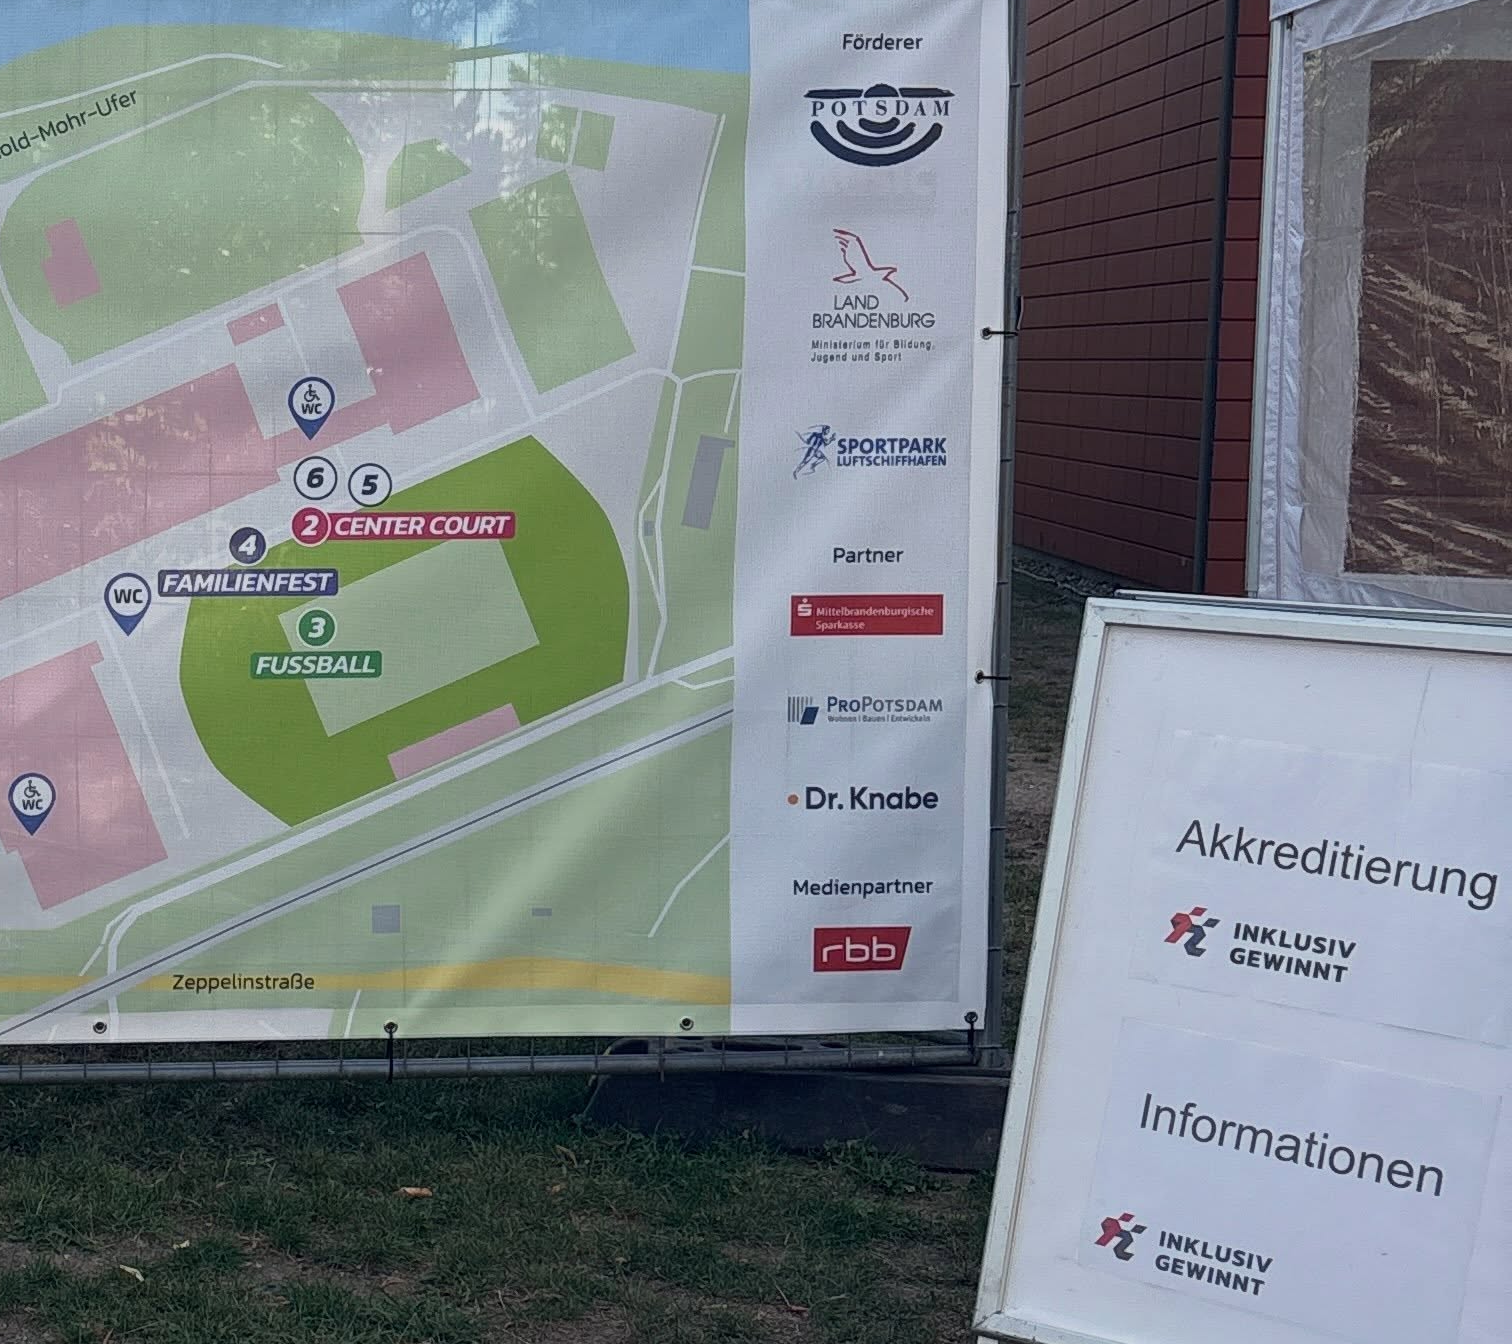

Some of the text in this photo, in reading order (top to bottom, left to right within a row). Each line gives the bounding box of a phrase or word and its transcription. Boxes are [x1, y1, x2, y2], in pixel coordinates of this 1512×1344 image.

[843, 33, 923, 50] Förderer
[811, 99, 950, 117] POTSDAM
[834, 295, 879, 310] LAND
[812, 313, 935, 328] BRANDENBURG
[811, 340, 871, 349] Ministerium
[875, 340, 889, 349] für
[810, 352, 902, 363] Jugend und Sport
[301, 403, 322, 415] WC
[837, 438, 947, 454] SPORTPARK
[837, 455, 947, 467] LUFTSCHIFFHAFEN
[307, 466, 325, 488] 6
[361, 473, 379, 496] 5
[302, 516, 511, 536] 2 CENTER COURT
[238, 536, 257, 556] 4
[833, 548, 904, 563] Partner
[163, 573, 334, 594] FAMILIENFEST
[114, 589, 144, 604] WC
[307, 618, 325, 638] 3
[815, 620, 866, 631] Sparkasse
[255, 658, 376, 675] FUSSBALL
[22, 798, 43, 811] WC
[805, 786, 939, 810] Dr. Knabe
[1175, 819, 1498, 911] Akkreditierung
[793, 879, 933, 899] Medienpartner
[822, 936, 896, 963] rbb
[1233, 922, 1357, 959] INKLUSIV
[1229, 947, 1349, 983] GEWINNT
[172, 973, 315, 993] Zeppelinstraße
[1140, 1093, 1444, 1197] Informationen
[1159, 1230, 1273, 1274] INKLUSIV
[1154, 1254, 1265, 1296] GEWINNT
